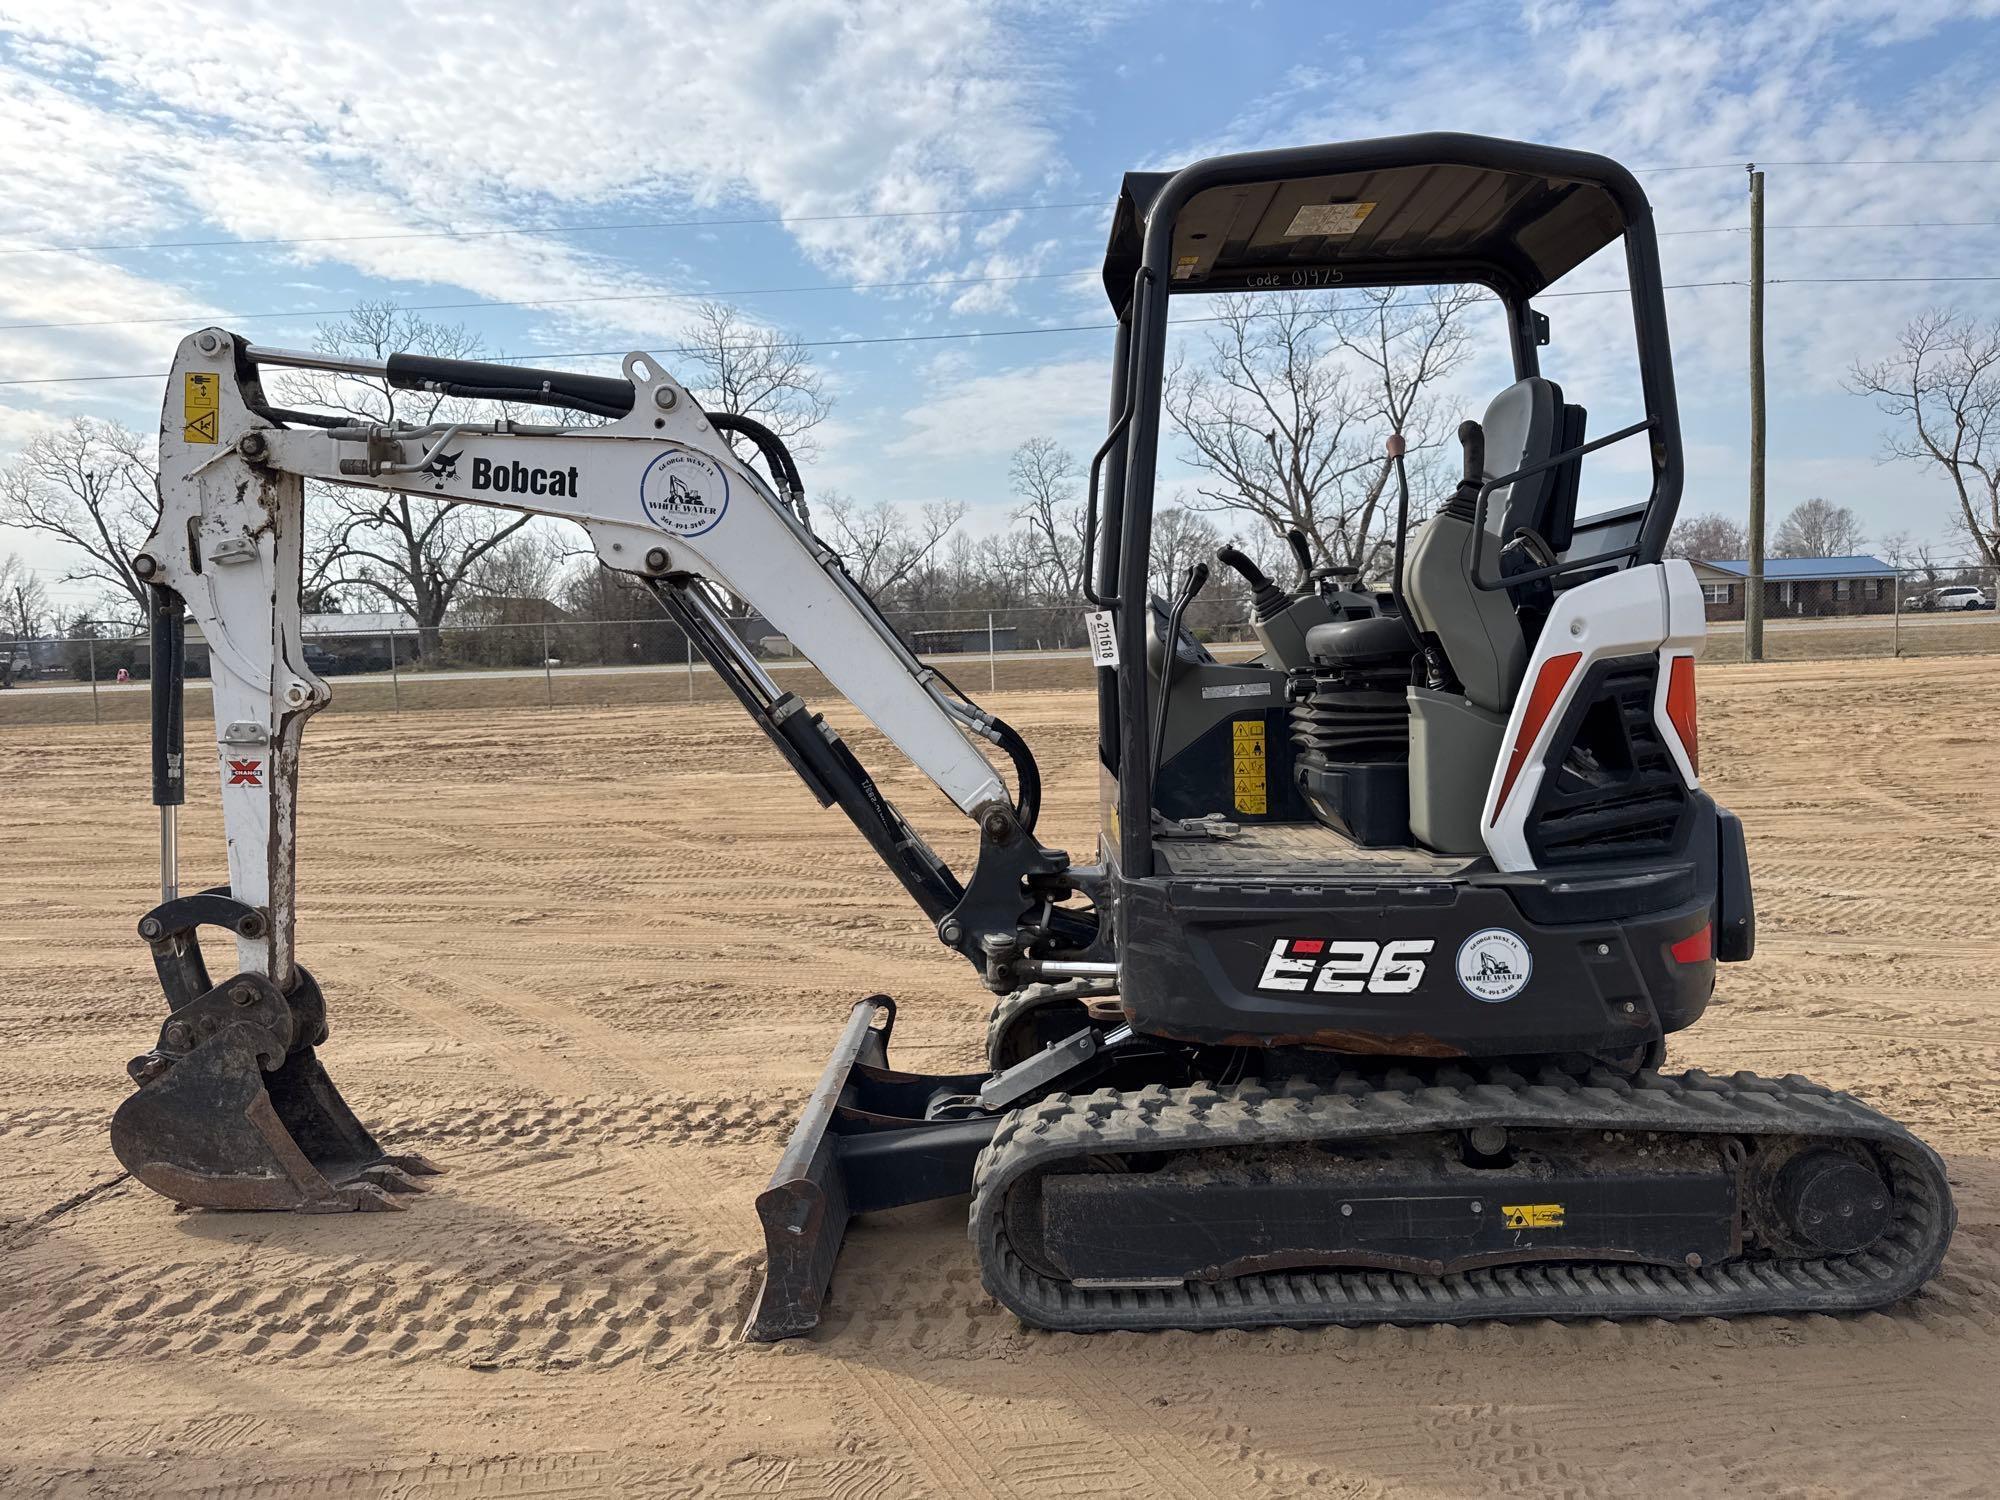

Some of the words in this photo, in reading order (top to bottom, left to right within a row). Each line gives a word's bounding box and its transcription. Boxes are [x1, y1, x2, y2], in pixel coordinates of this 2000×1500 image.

[1246, 270, 1281, 287] Code
[658, 457, 685, 472] GEORGE
[706, 467, 714, 476] TX
[472, 457, 578, 498] Bobcat
[649, 501, 681, 511] WHITE
[682, 505, 717, 515] WATER
[1096, 622, 1114, 659] 211618
[1470, 935, 1491, 951] GEORGE
[1257, 939, 1435, 993] E26
